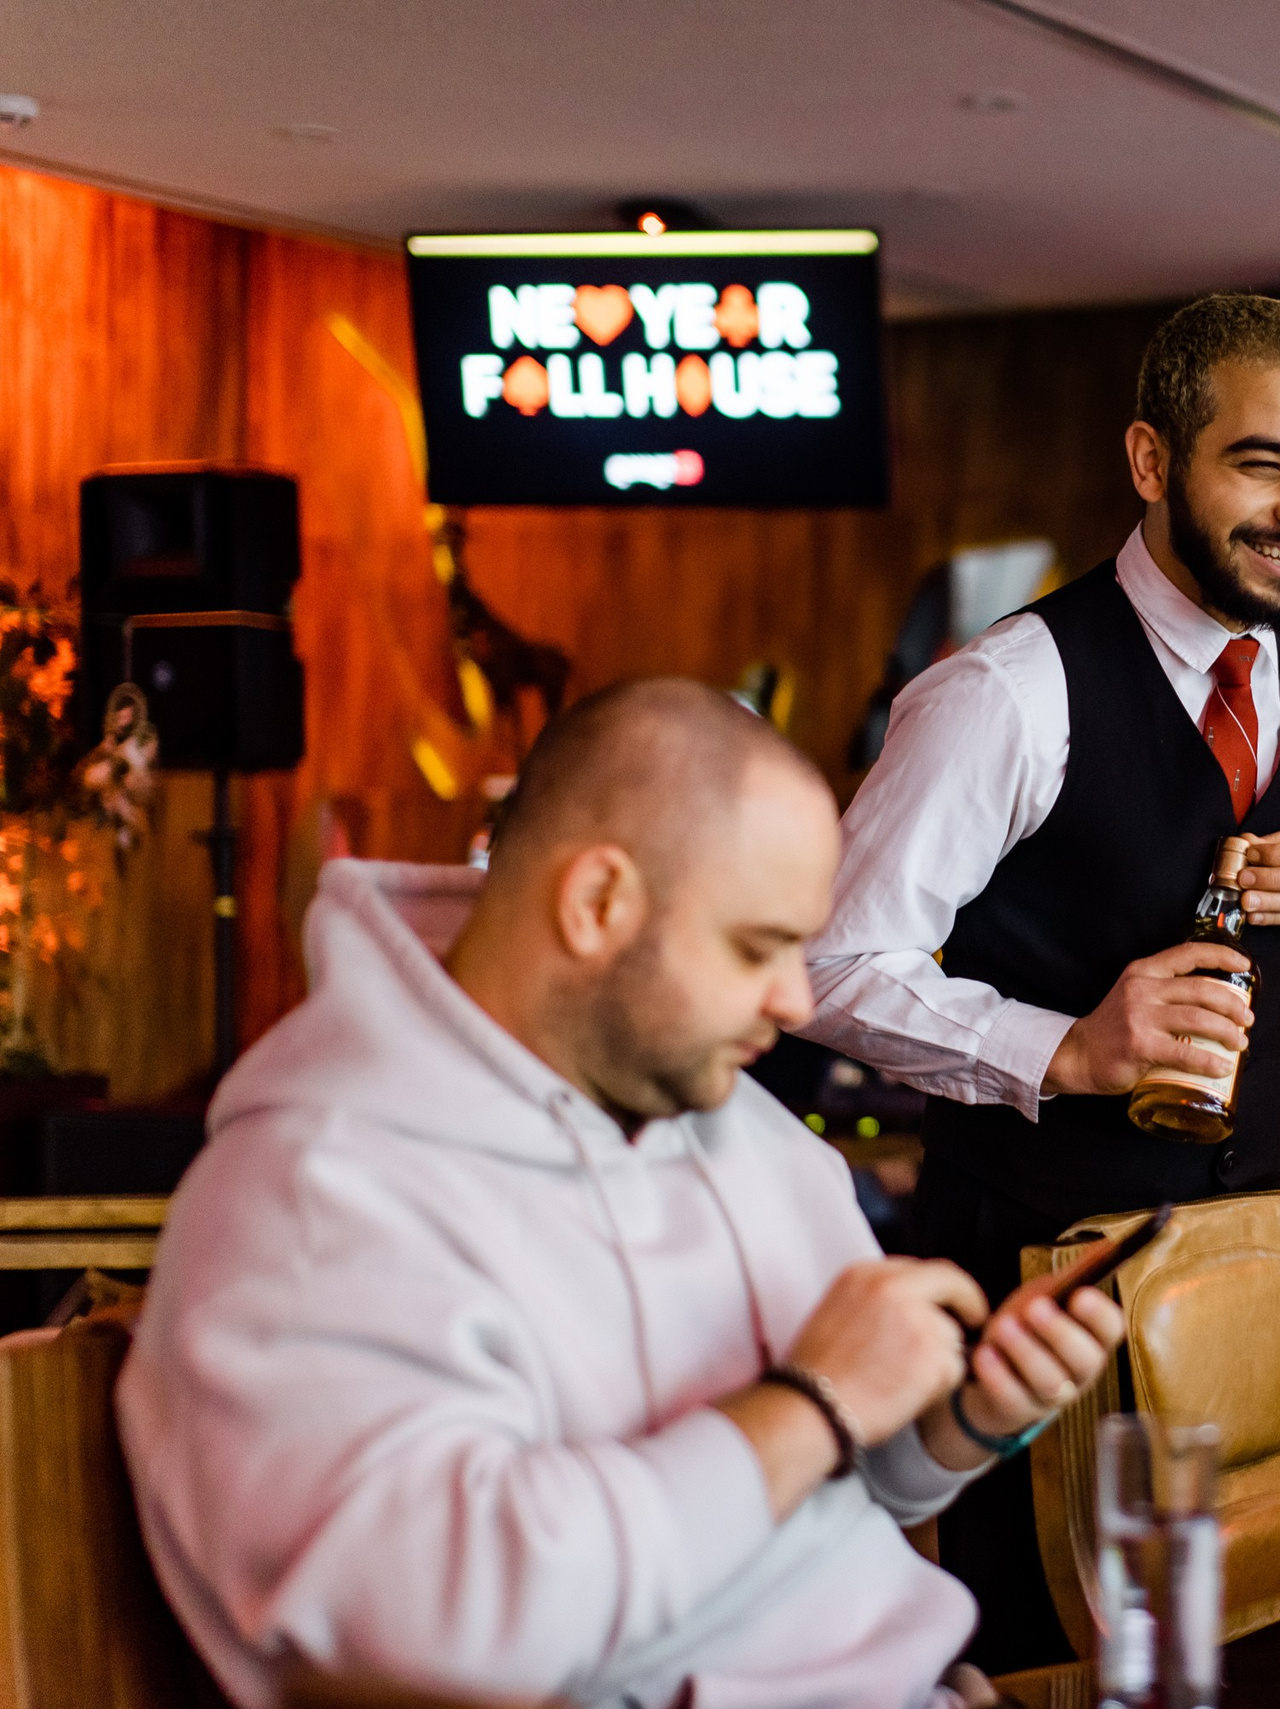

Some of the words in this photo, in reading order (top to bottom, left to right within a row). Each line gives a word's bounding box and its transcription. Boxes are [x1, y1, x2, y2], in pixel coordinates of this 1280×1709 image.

[488, 283, 634, 349] NE
[628, 281, 811, 350] YER
[461, 352, 623, 418] FLL
[621, 350, 841, 418] HUSE
